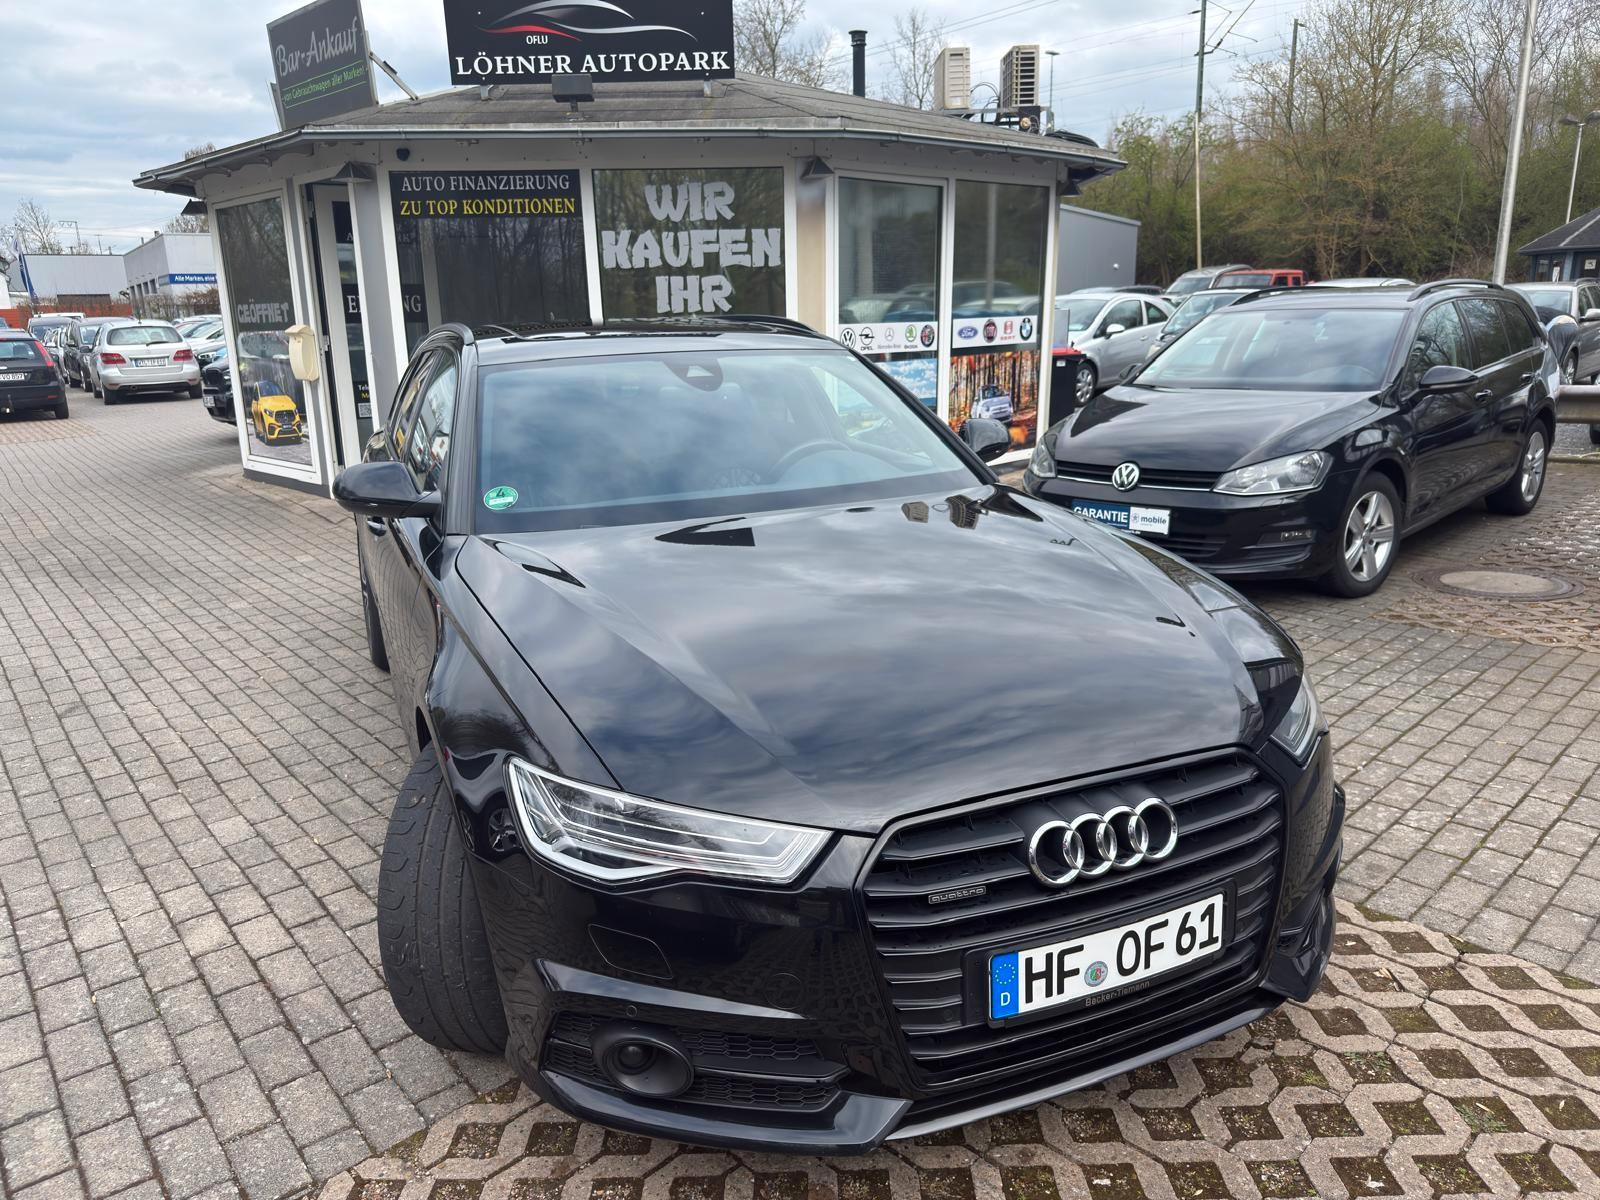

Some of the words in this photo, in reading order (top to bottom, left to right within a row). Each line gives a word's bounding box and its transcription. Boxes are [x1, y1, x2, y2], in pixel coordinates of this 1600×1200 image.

[275, 16, 358, 77] Bar-Ankauf
[525, 35, 549, 45] OFLU
[456, 52, 573, 76] LÖHNER
[580, 51, 730, 73] AUTOPARK
[402, 176, 445, 191] AUTO
[450, 174, 570, 191] FINANZIERUNG
[400, 200, 421, 216] ZU
[426, 200, 458, 215] TOP
[463, 198, 576, 215] KONDITIONEN
[644, 181, 736, 222] WIR
[601, 228, 782, 270] KAUFEN
[655, 274, 733, 314] IHR
[237, 298, 290, 324] GEÖFFNET
[1073, 506, 1128, 523] GARANTIE
[1140, 515, 1167, 525] mobile
[931, 888, 984, 902] quattro
[1024, 943, 1085, 1004] HF
[1116, 918, 1169, 977] OF
[1175, 902, 1219, 956] 61
[1000, 992, 1011, 1006] D
